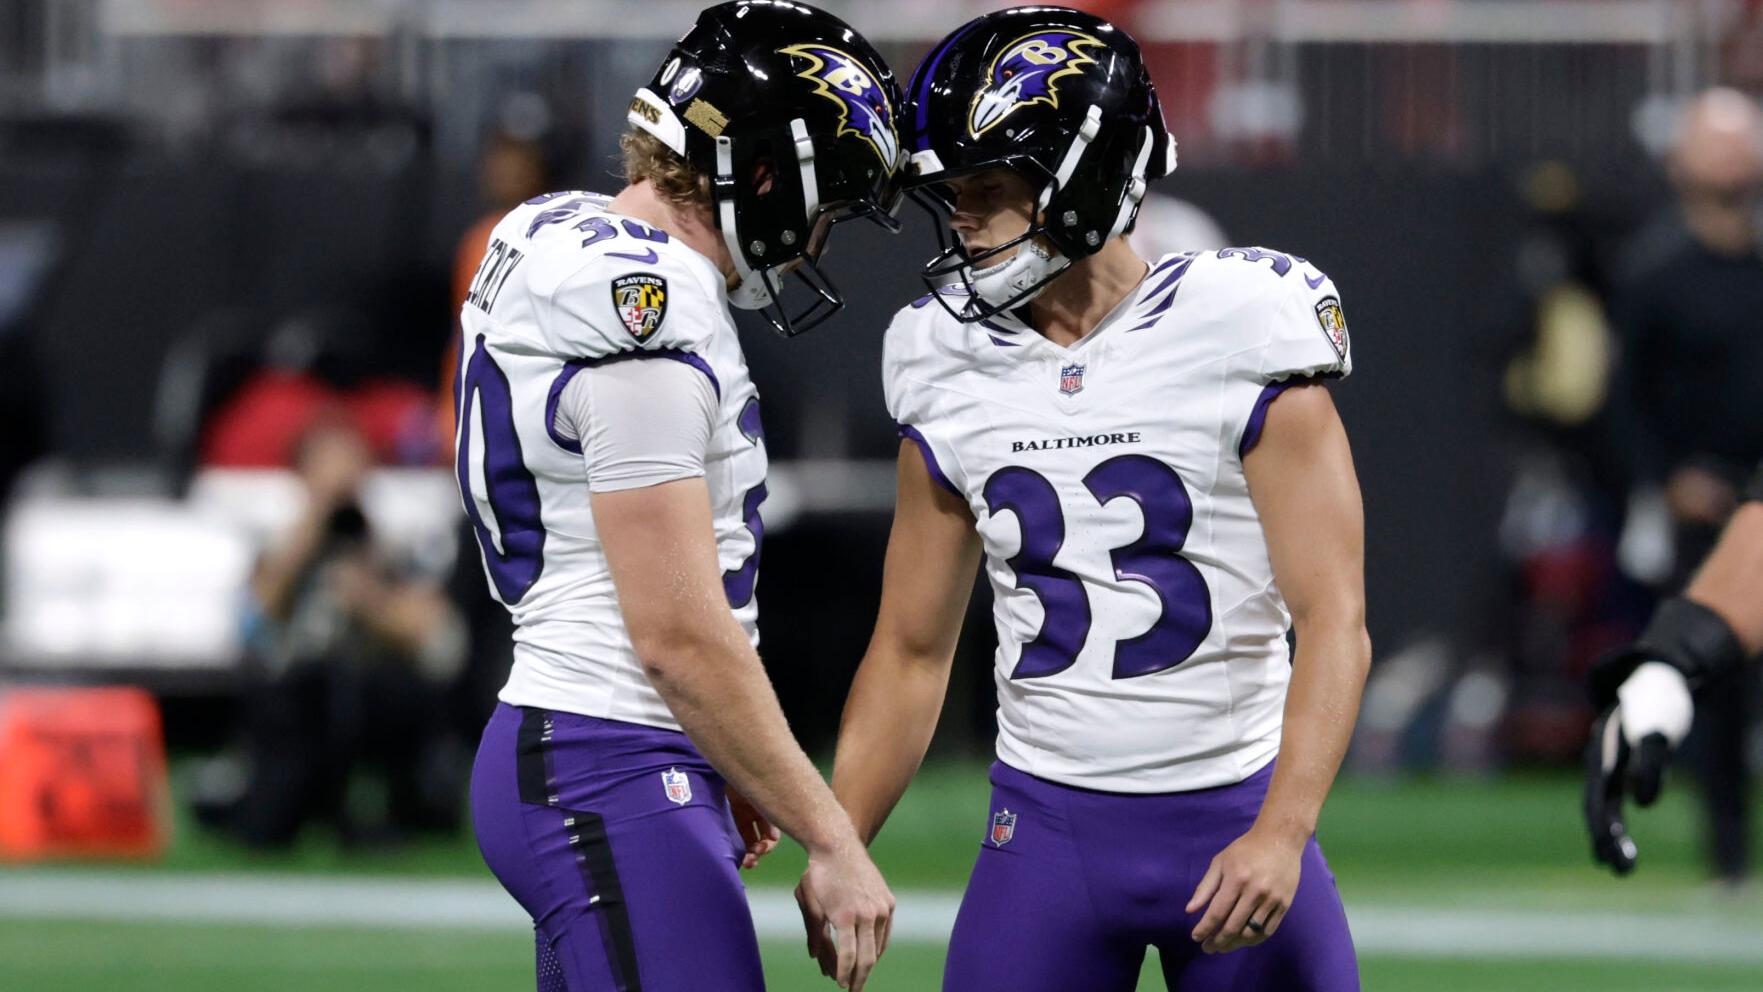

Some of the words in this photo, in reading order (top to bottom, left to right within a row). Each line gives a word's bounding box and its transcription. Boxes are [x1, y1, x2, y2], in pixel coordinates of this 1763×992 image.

[615, 276, 663, 287] RAVENS
[455, 320, 546, 606] 0
[1012, 432, 1141, 453] BALTIMORE
[982, 454, 1213, 680] 33
